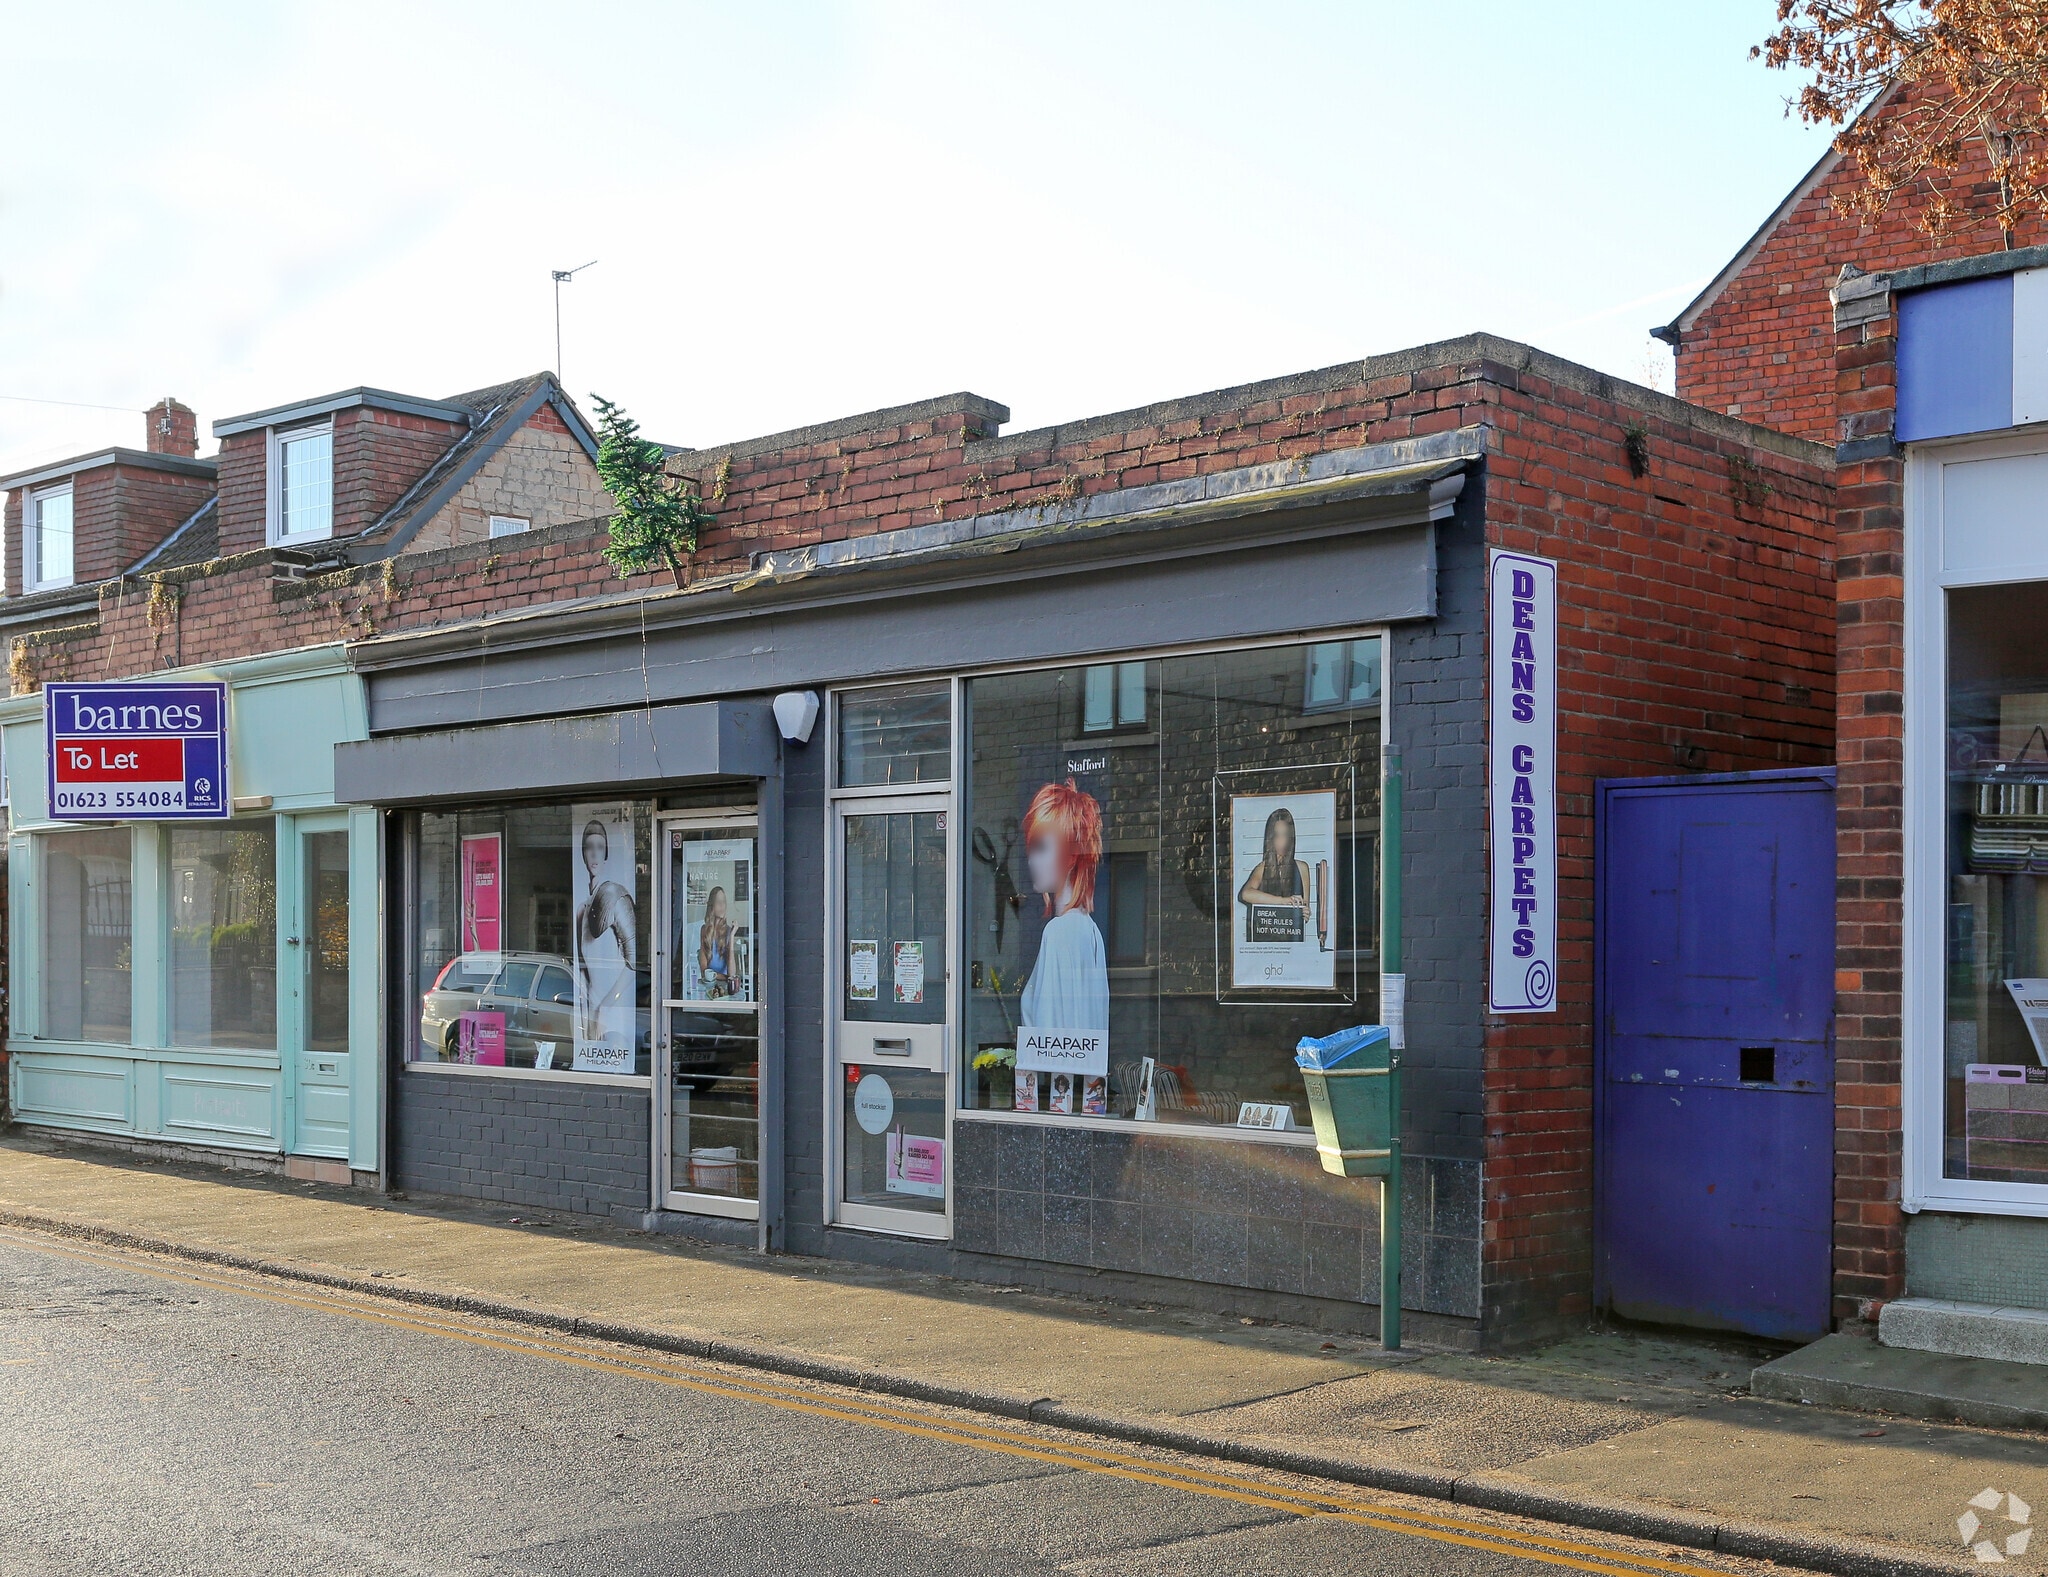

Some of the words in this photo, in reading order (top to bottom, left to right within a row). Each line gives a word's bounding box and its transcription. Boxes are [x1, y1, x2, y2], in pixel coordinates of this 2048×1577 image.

[1511, 568, 1536, 723] DEANS
[70, 694, 202, 731] barnes
[63, 747, 92, 770] To
[101, 747, 138, 769] Let
[1067, 757, 1105, 772] Stafford
[58, 792, 107, 808] 01623
[116, 791, 183, 807] 554084
[704, 848, 731, 856] ALFAPARF
[1511, 744, 1536, 958] CARPETS
[689, 872, 719, 881] NATURE
[1264, 963, 1284, 979] ghd
[1026, 1035, 1100, 1052] ALFAPARF
[579, 1047, 629, 1060] ALFAPARF
[1037, 1050, 1086, 1059] MILANO
[868, 1103, 886, 1111] stockist
